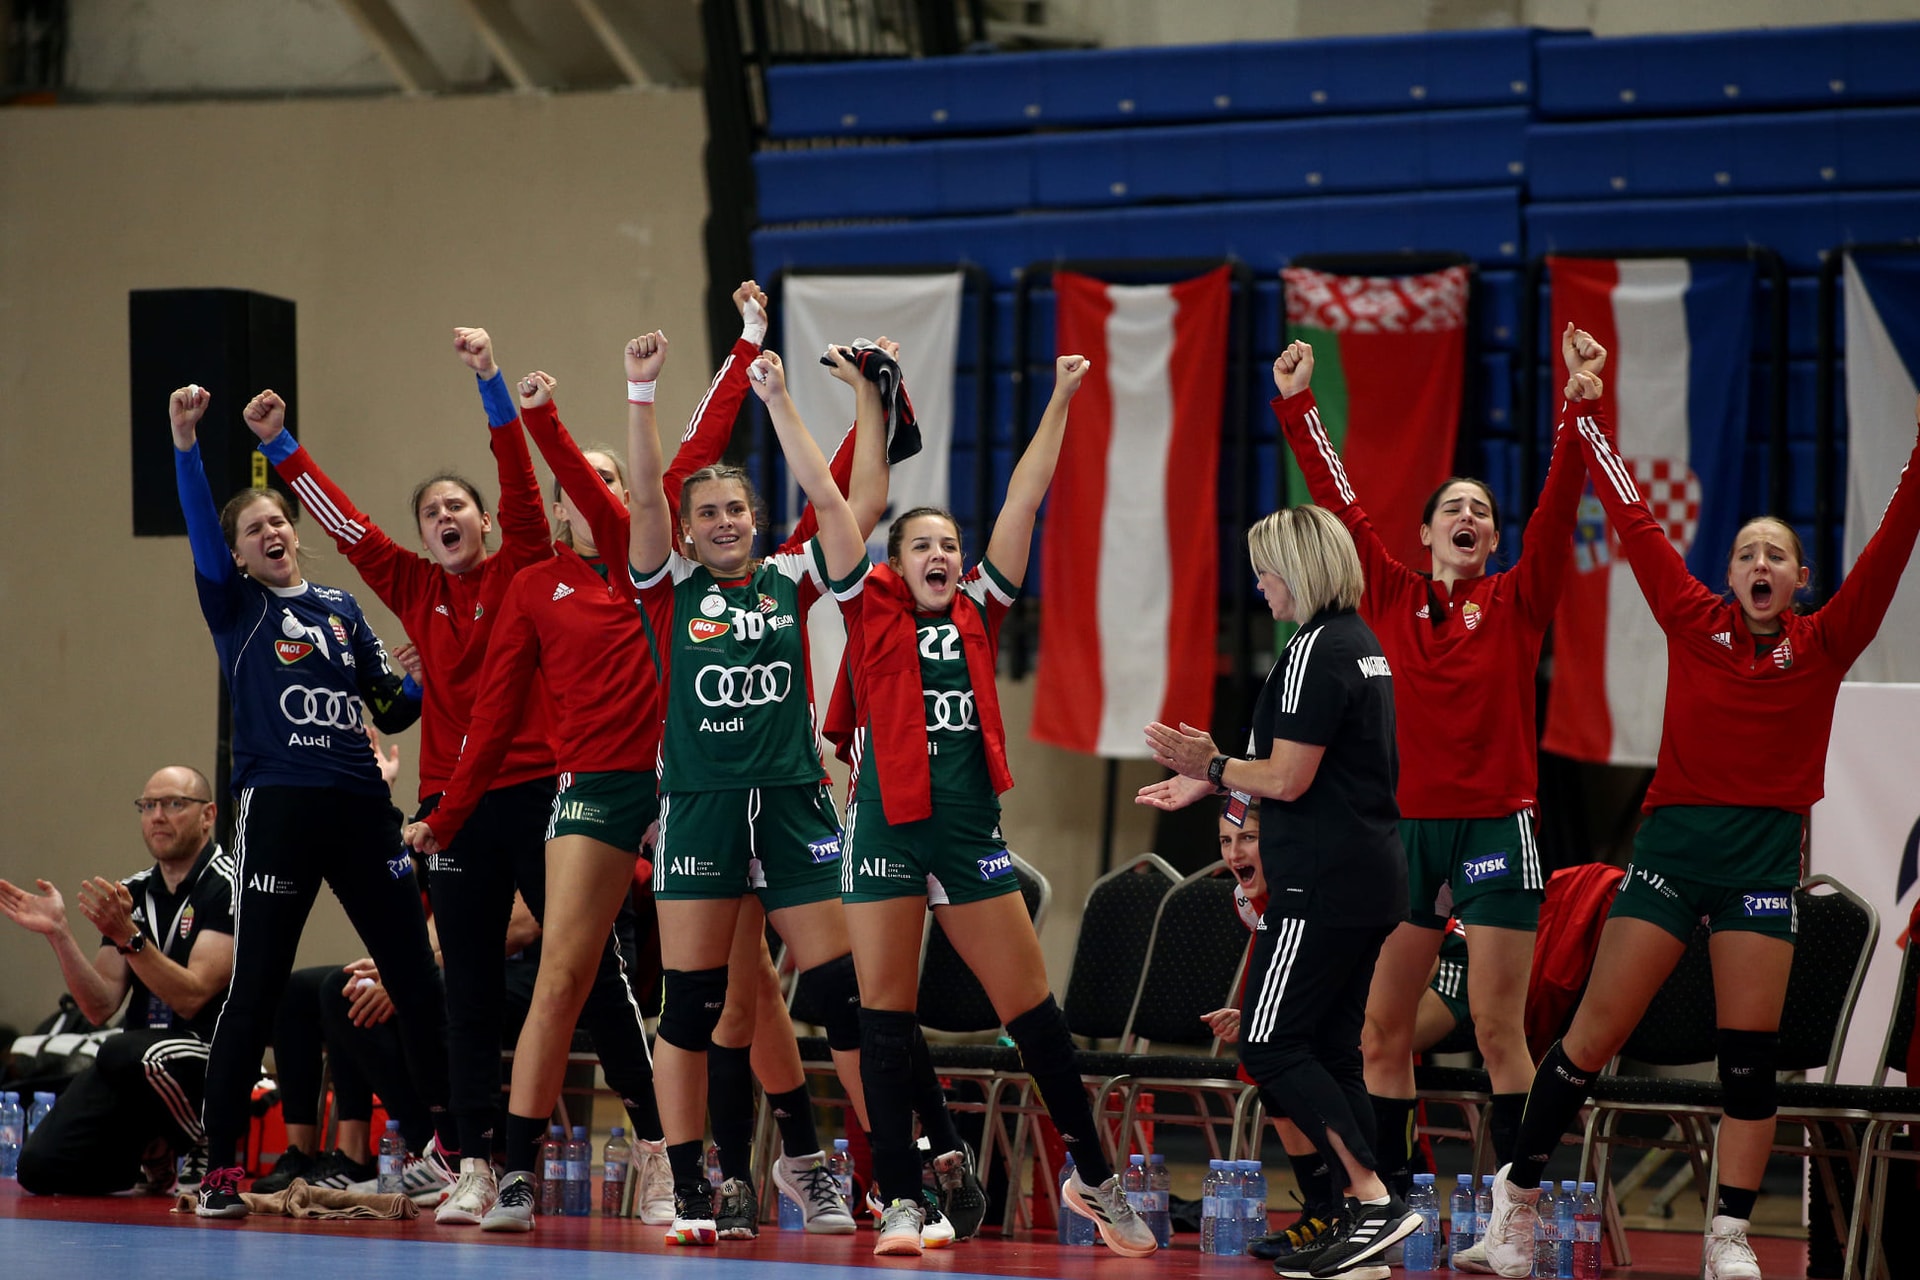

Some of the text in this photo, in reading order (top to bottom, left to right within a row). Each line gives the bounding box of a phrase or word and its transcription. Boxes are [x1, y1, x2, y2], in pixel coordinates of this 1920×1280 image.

[693, 621, 717, 633] MOL
[728, 607, 765, 641] 30
[280, 643, 301, 654] MOL
[916, 624, 960, 660] 22
[699, 718, 745, 732] Audi
[288, 732, 331, 748] Audi
[560, 801, 584, 820] All
[670, 856, 696, 876] All
[858, 857, 887, 877] All
[1473, 857, 1507, 876] JYSK
[247, 872, 275, 894] All
[1754, 897, 1789, 910] JYSK
